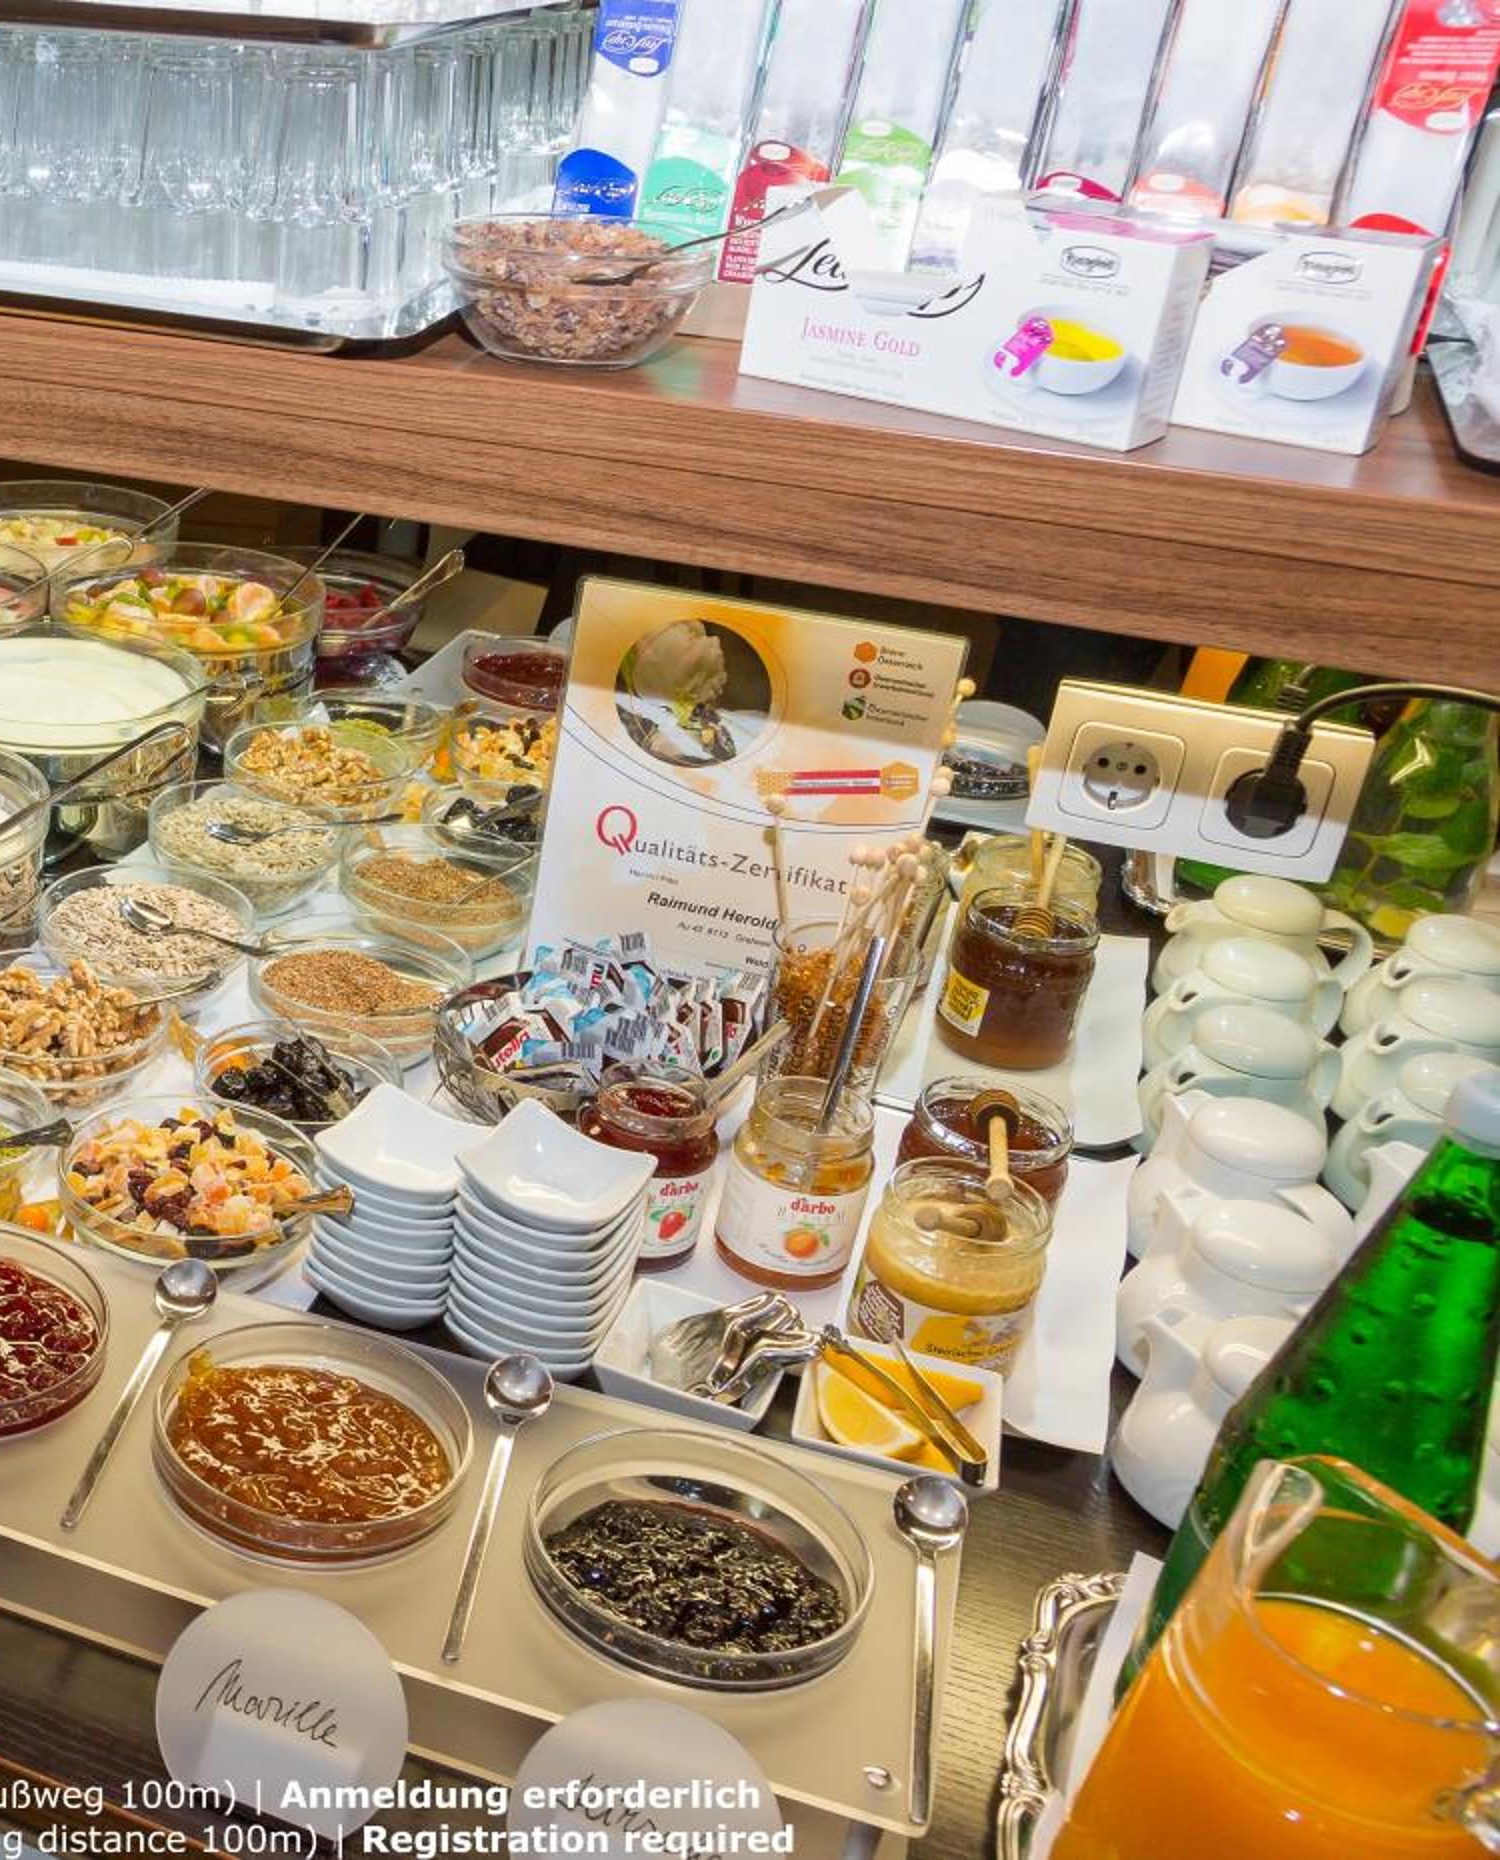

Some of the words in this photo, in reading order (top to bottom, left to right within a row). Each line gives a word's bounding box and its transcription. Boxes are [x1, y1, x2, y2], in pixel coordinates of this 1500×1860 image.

[596, 804, 848, 896] Qualitäts-Zerifikat
[647, 890, 720, 918] Raimund
[721, 908, 780, 932] Herold
[491, 1029, 531, 1069] utella
[193, 1657, 339, 1750] Marille
